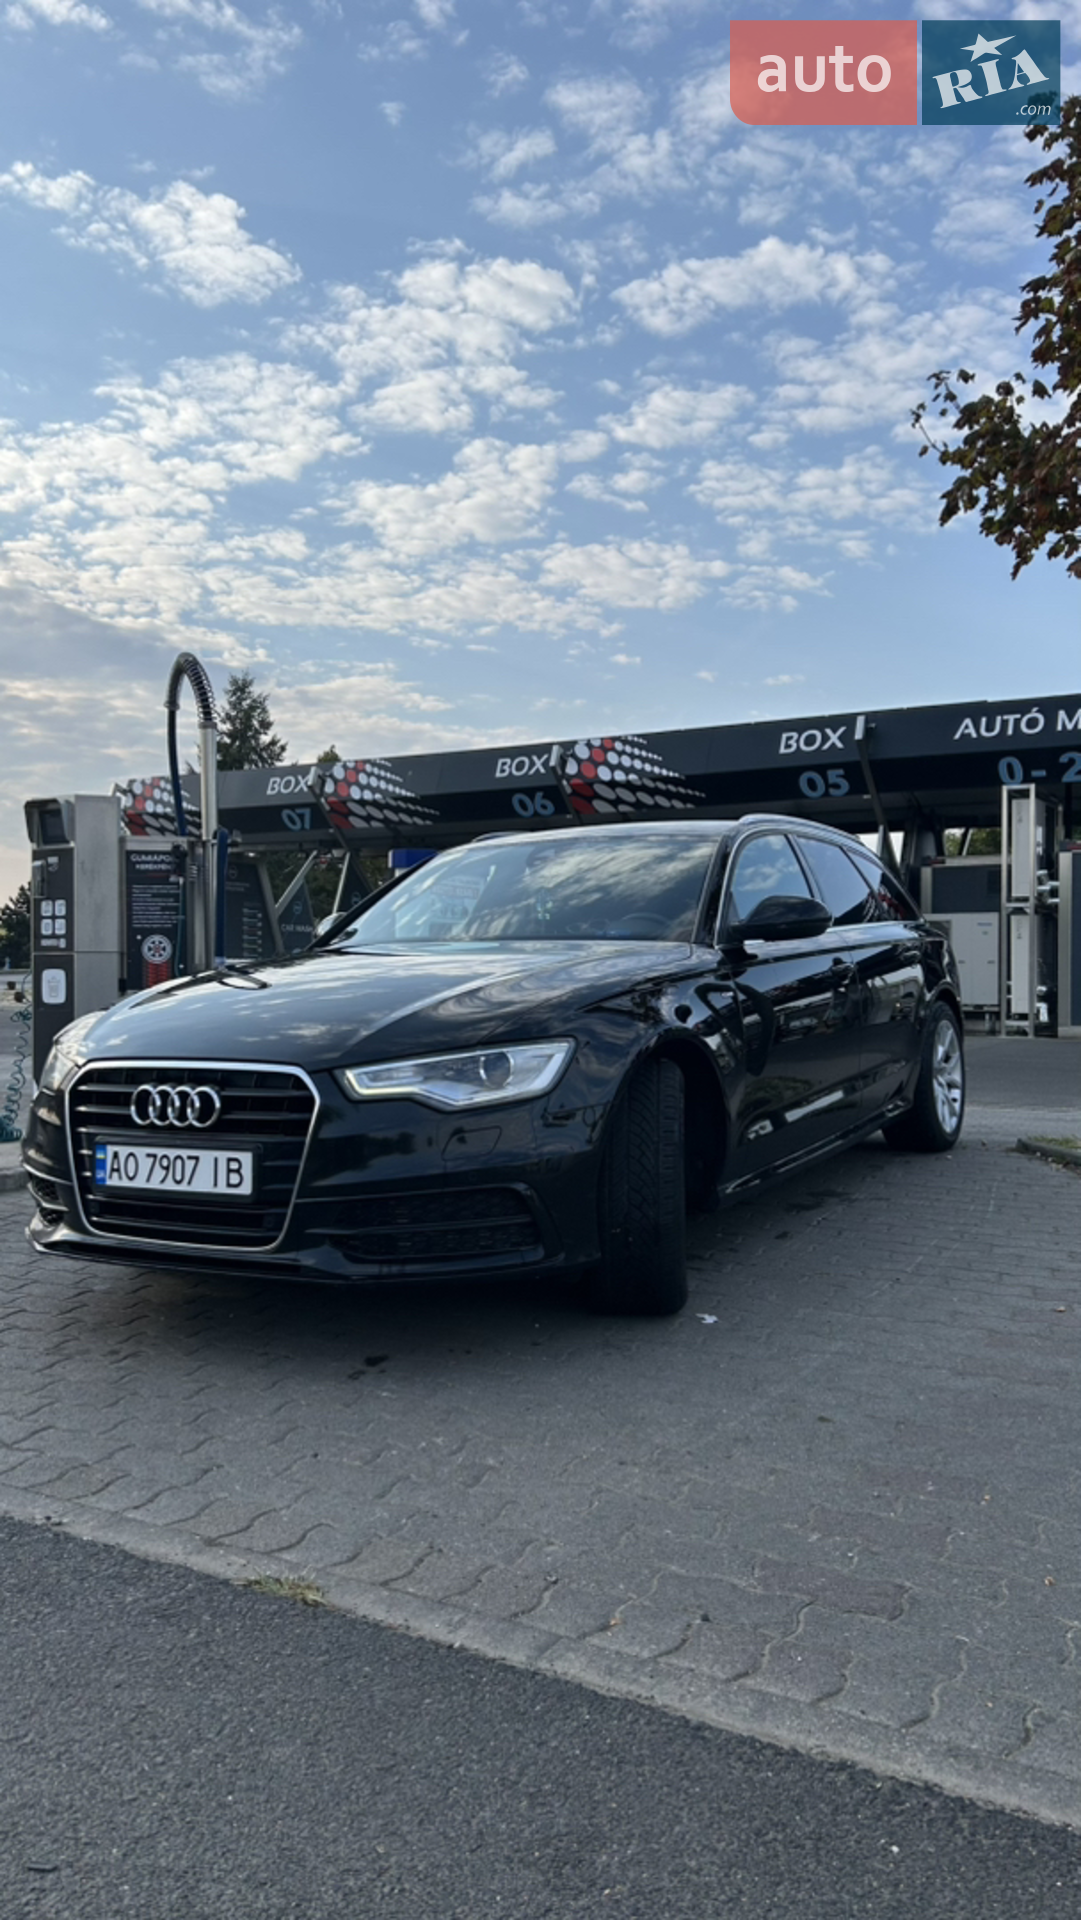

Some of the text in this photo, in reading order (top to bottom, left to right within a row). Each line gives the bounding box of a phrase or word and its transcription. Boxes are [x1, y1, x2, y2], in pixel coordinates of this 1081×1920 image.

[953, 707, 1045, 740] AUTÓ
[779, 725, 847, 755] BOX
[495, 753, 549, 778] BOX
[998, 756, 1023, 785] 0
[266, 774, 309, 795] BOX
[798, 768, 851, 799] 05
[281, 807, 312, 831] 07
[511, 791, 555, 818] 06
[108, 1151, 244, 1188] AO 7907 IB
